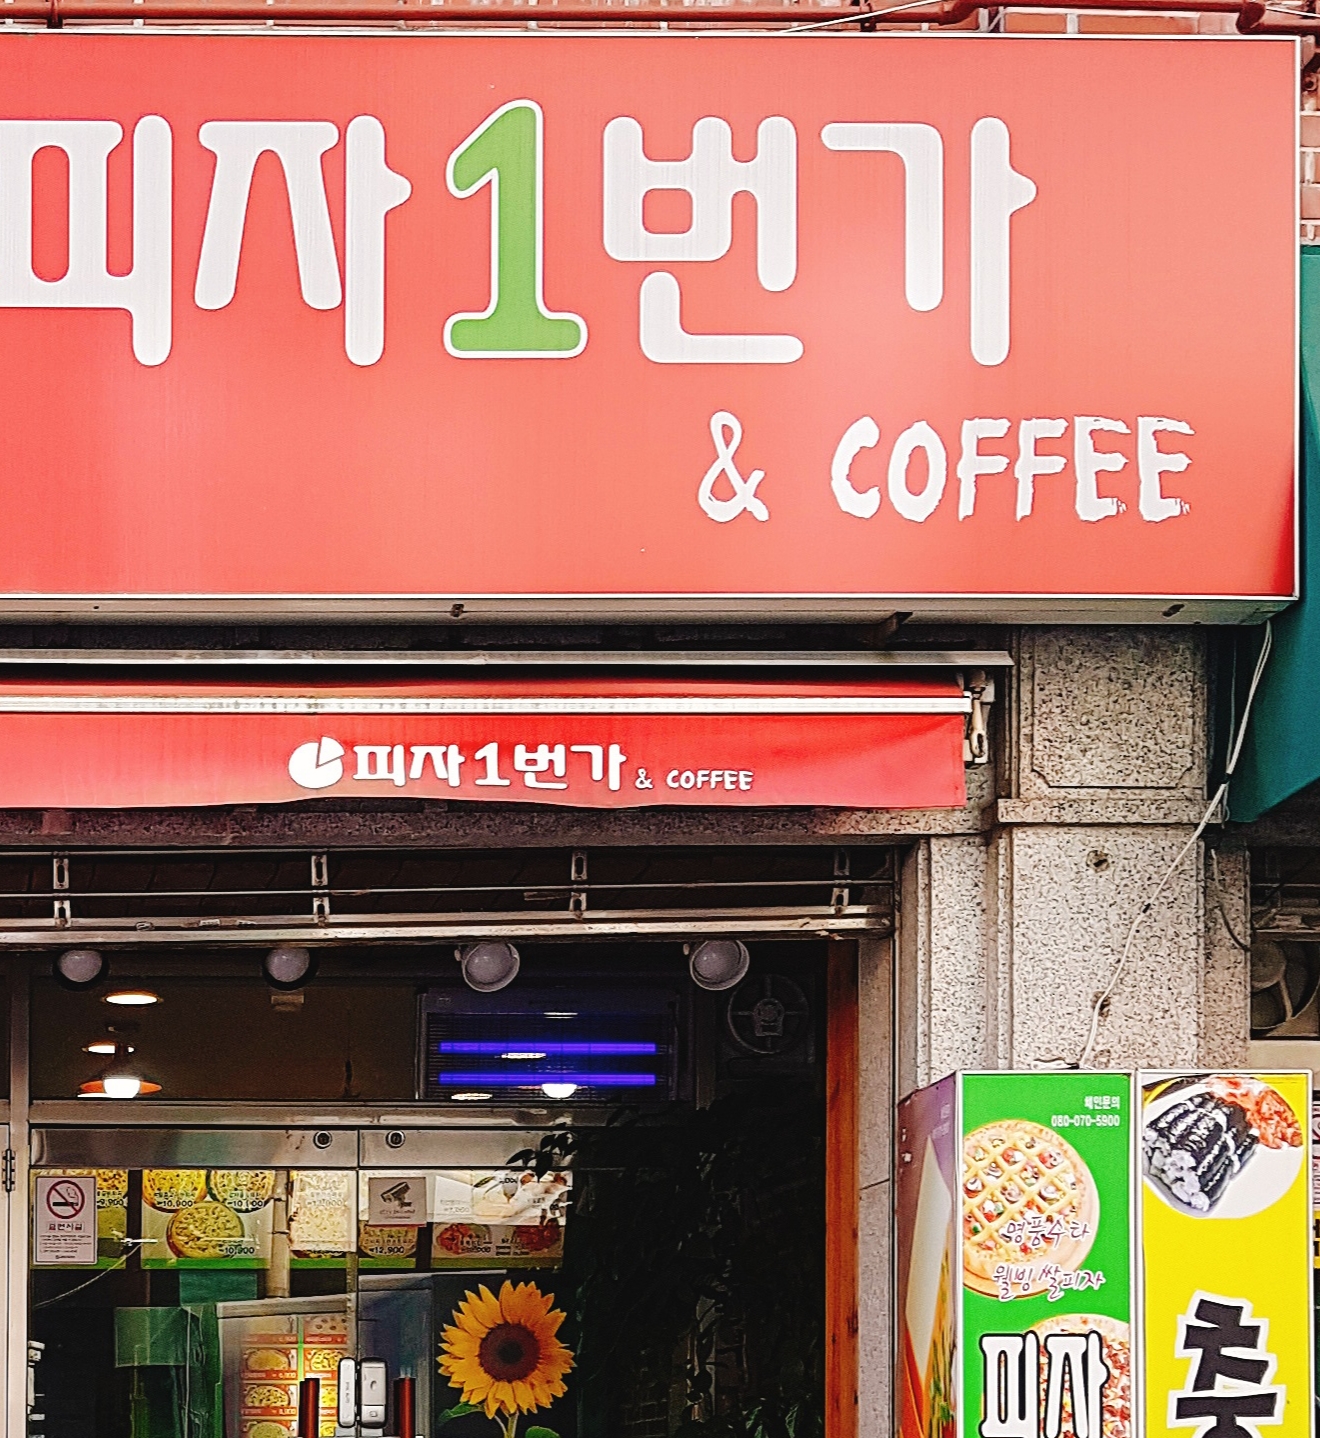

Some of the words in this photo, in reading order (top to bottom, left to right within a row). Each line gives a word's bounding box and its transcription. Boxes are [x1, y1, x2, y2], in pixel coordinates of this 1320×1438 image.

[698, 411, 769, 522] &
[830, 415, 1194, 523] COFFEE
[634, 768, 654, 790] &
[666, 768, 755, 790] COFFEE
[1051, 1115, 1120, 1127] 080-070-5900
